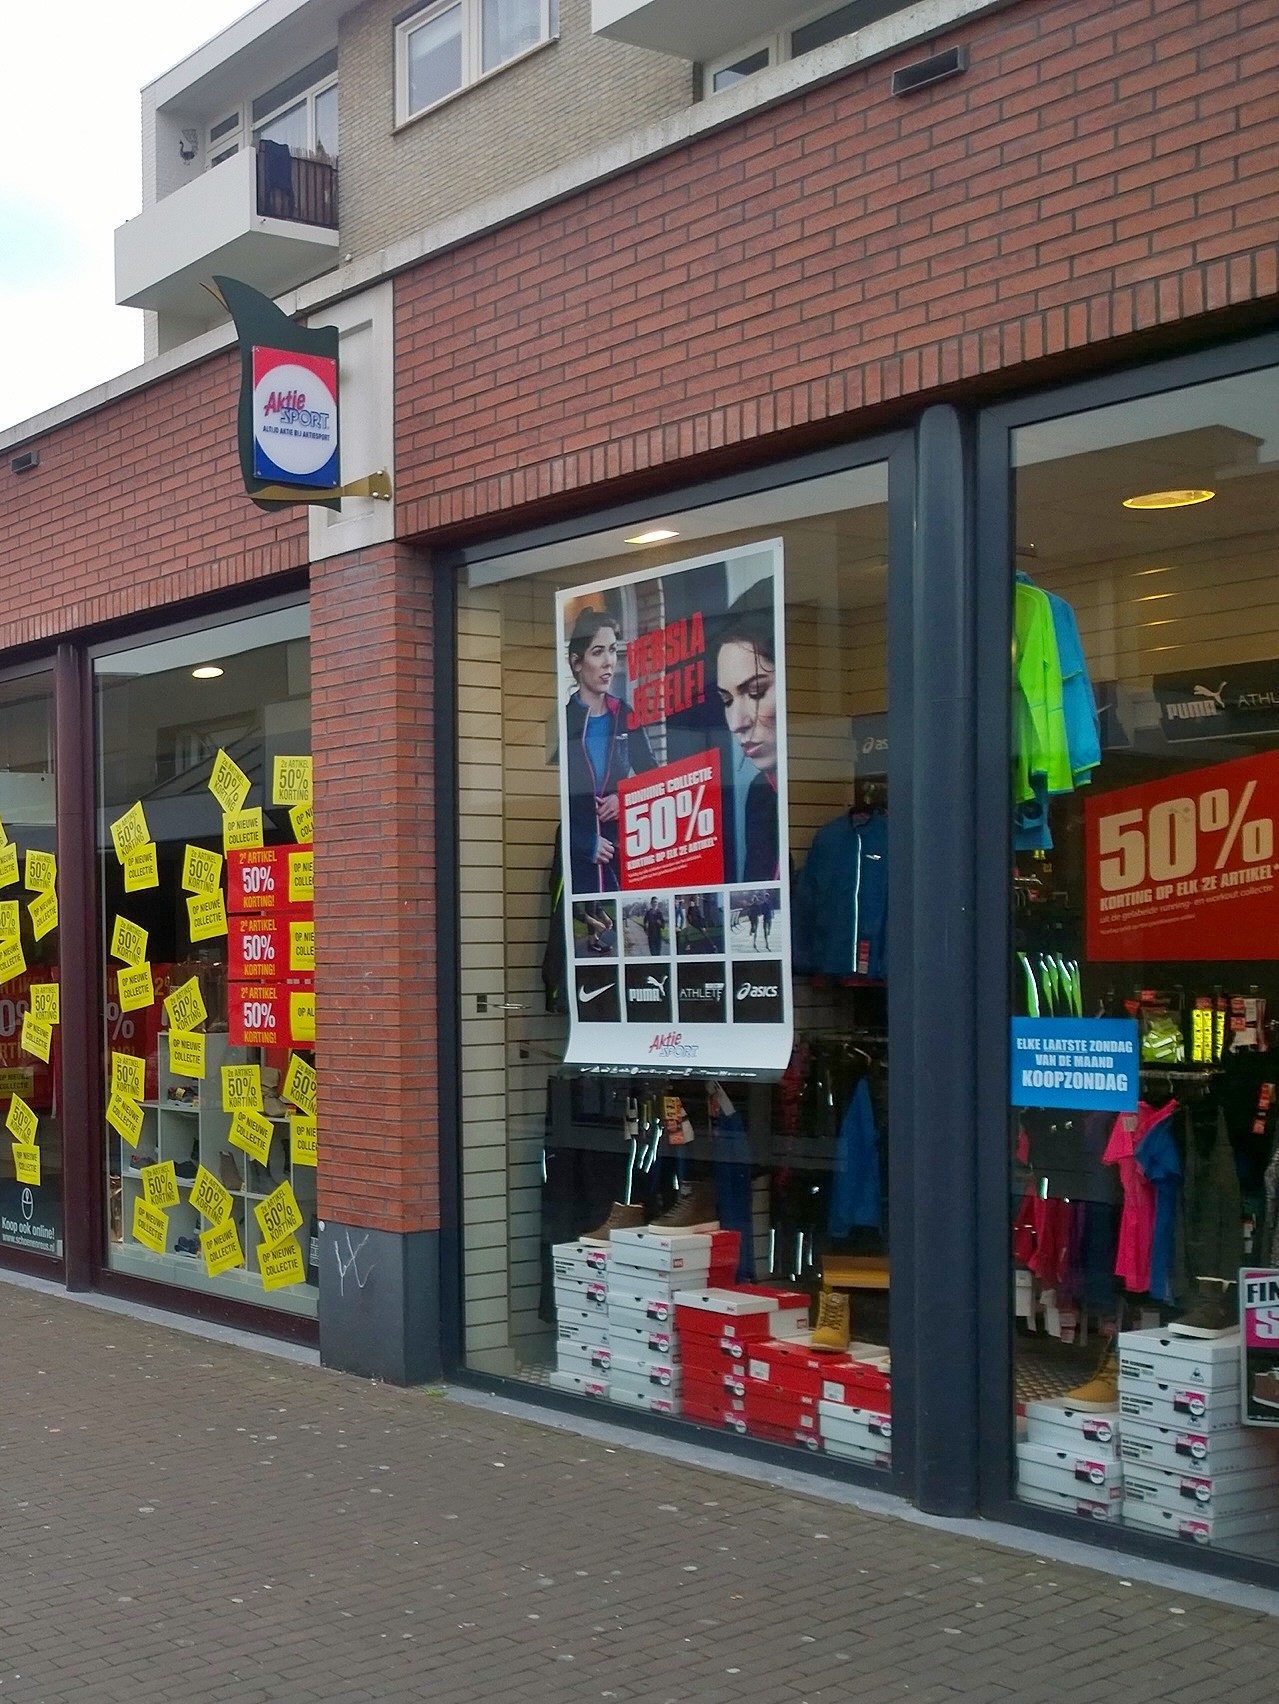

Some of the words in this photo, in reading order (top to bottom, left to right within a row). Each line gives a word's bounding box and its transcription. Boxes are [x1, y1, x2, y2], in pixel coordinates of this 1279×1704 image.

[264, 390, 306, 417] Aktie
[280, 407, 330, 430] SPORT
[263, 425, 279, 433] ALTIJD
[280, 428, 293, 436] AKTIE
[294, 429, 302, 437] BIJ
[303, 431, 330, 441] AKTIESPORT
[627, 611, 705, 682] VERSLA
[626, 659, 705, 731] JEZELF!
[1166, 700, 1216, 720] PUMA
[218, 765, 239, 801] 50%
[279, 769, 308, 789] 50%
[625, 782, 665, 807] RUNNING
[666, 766, 713, 793] COLLECTIE
[214, 782, 236, 811] KORTING
[279, 789, 309, 800] KORTING
[228, 822, 235, 831] OP
[236, 818, 259, 830] NIEUWE
[296, 813, 304, 825] OP
[625, 784, 714, 857] 50%
[117, 820, 141, 848] 50%
[228, 831, 259, 844] COLLECTIE
[1099, 780, 1274, 892] 50%
[248, 850, 277, 864] ARTIKEL
[655, 852, 665, 862] OP
[189, 859, 215, 882] 50%
[293, 863, 301, 872] OP
[188, 877, 214, 893] KORTING
[242, 865, 275, 893] 50%
[1100, 889, 1152, 912] KORTING
[1156, 885, 1173, 901] OP
[1177, 880, 1198, 896] ELK
[1201, 876, 1218, 890] 2E
[1240, 884, 1275, 897] collectie
[192, 906, 199, 915] OP
[200, 899, 221, 914] NIEUWE
[243, 895, 275, 908] KORTING!
[194, 914, 222, 928] COLLECTIE
[248, 919, 277, 931] ARTIKEL
[118, 928, 141, 956] 50%
[295, 932, 302, 941] OP
[243, 934, 275, 960] 50%
[244, 964, 276, 976] KORTING!
[35, 994, 57, 1011] 50%
[249, 988, 277, 999] ARTIKEL
[629, 988, 662, 1002] PUMA
[750, 985, 778, 998] asics
[172, 993, 198, 1023] 50%
[243, 1002, 276, 1028] 50%
[297, 1007, 306, 1017] OP
[244, 1031, 277, 1044] KORTING!
[648, 1031, 682, 1053] Aktie
[1016, 1038, 1041, 1051] ELKE
[1043, 1038, 1088, 1053] LAATSTE
[1089, 1040, 1134, 1053] ZONDAG
[174, 1051, 201, 1065] COLLECTIE
[659, 1045, 699, 1058] SPORT
[1035, 1054, 1056, 1067] VAN
[1059, 1055, 1072, 1067] DE
[1074, 1055, 1114, 1069] MAAND
[116, 1064, 139, 1086] 50%
[1022, 1070, 1128, 1092] KOOPZONDAG
[228, 1076, 256, 1097] 50%
[229, 1096, 257, 1107] KORTING
[13, 1107, 31, 1135] 50%
[238, 1112, 246, 1121] OP
[246, 1115, 269, 1139] NIEUWE
[236, 1124, 266, 1151] COLLECTIE
[297, 1126, 305, 1136] OP
[148, 1174, 172, 1195] 50%
[199, 1180, 223, 1216] 50%
[263, 1199, 292, 1232] 50%
[2, 1217, 18, 1233] Koop
[19, 1222, 31, 1235] ook
[32, 1225, 55, 1240] online!
[270, 1214, 296, 1241] KORTING
[2, 1234, 55, 1252] www.schoenenreus.nl
[210, 1243, 237, 1262] COLLECTIE
[263, 1252, 271, 1263] OP
[271, 1245, 296, 1260] NIEUWE
[266, 1259, 298, 1277] COLLECTIE
